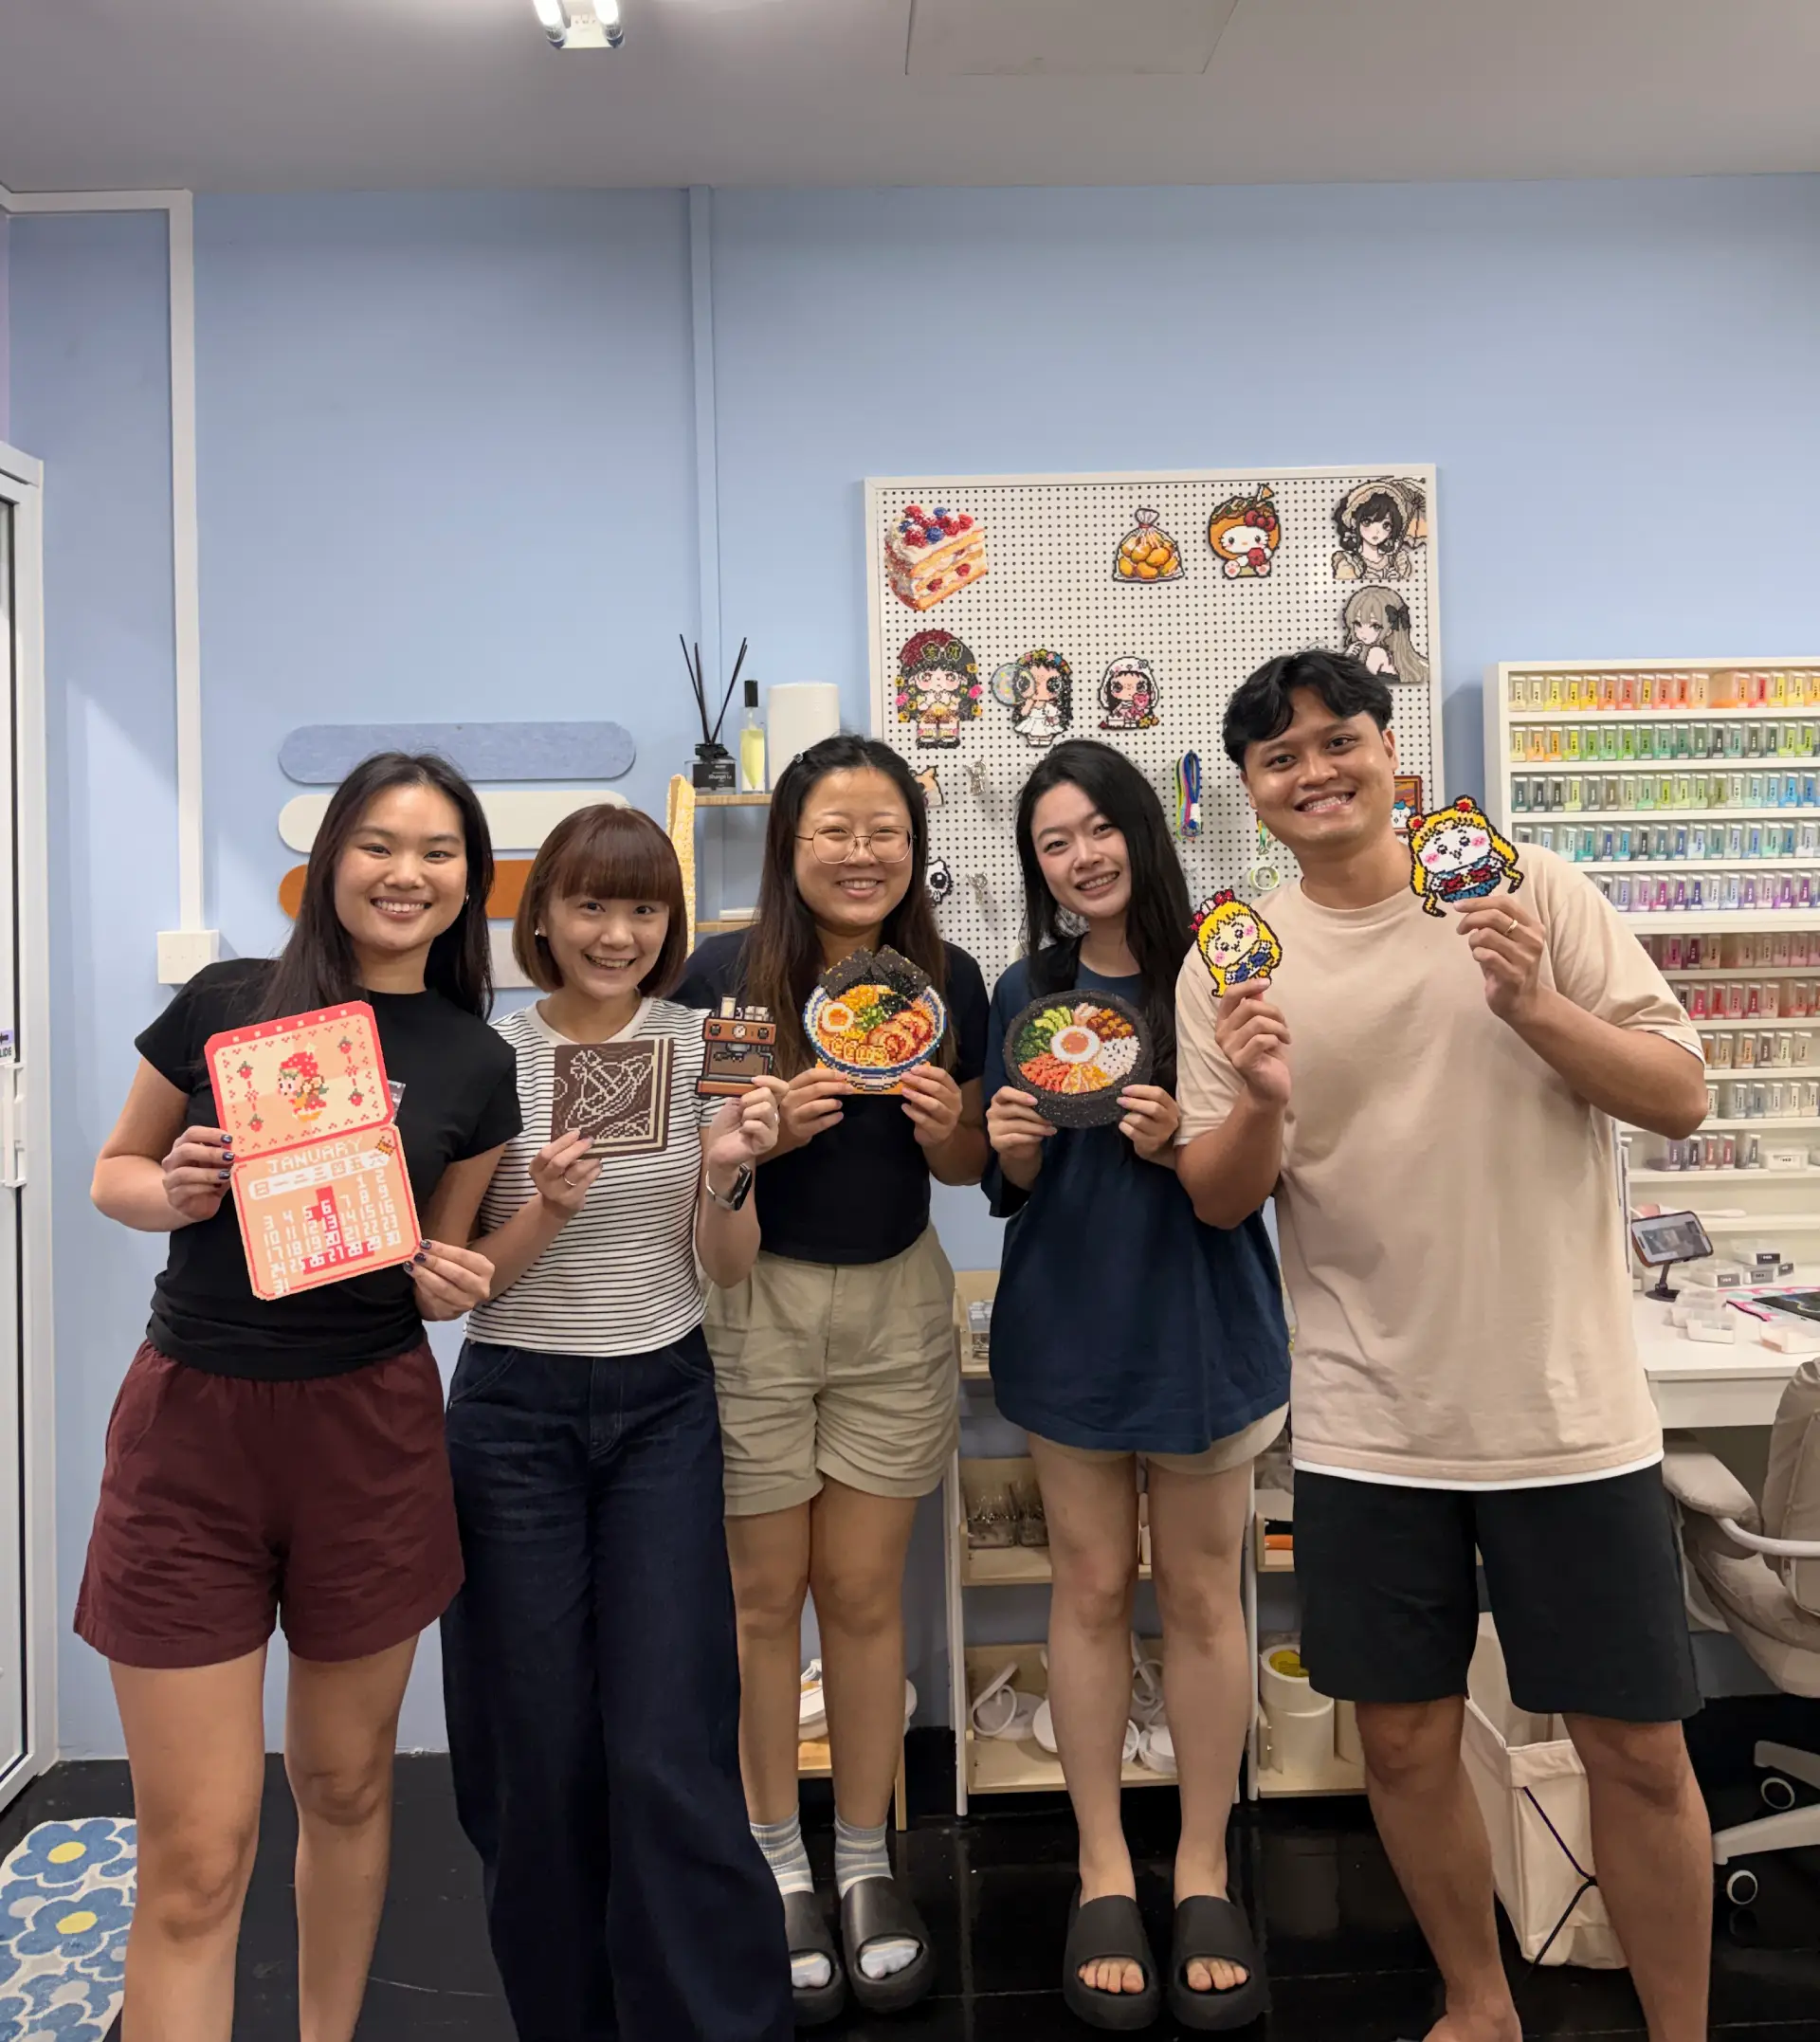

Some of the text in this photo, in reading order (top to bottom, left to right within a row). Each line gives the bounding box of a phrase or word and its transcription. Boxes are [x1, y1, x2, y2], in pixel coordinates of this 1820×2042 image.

[266, 1137, 363, 1174] JANUARY
[356, 1169, 386, 1189] 1 2
[264, 1185, 389, 1230] 3 4 5 6 7 8 9
[264, 1199, 394, 1247] 10 11 12 13 14 15 16
[266, 1247, 283, 1262] 17
[286, 1241, 301, 1257] 18
[305, 1236, 321, 1252] 19
[344, 1225, 361, 1241] 21
[363, 1220, 378, 1236] 22
[382, 1214, 398, 1231] 23
[328, 1246, 344, 1262] 27
[274, 1278, 290, 1295] 31
